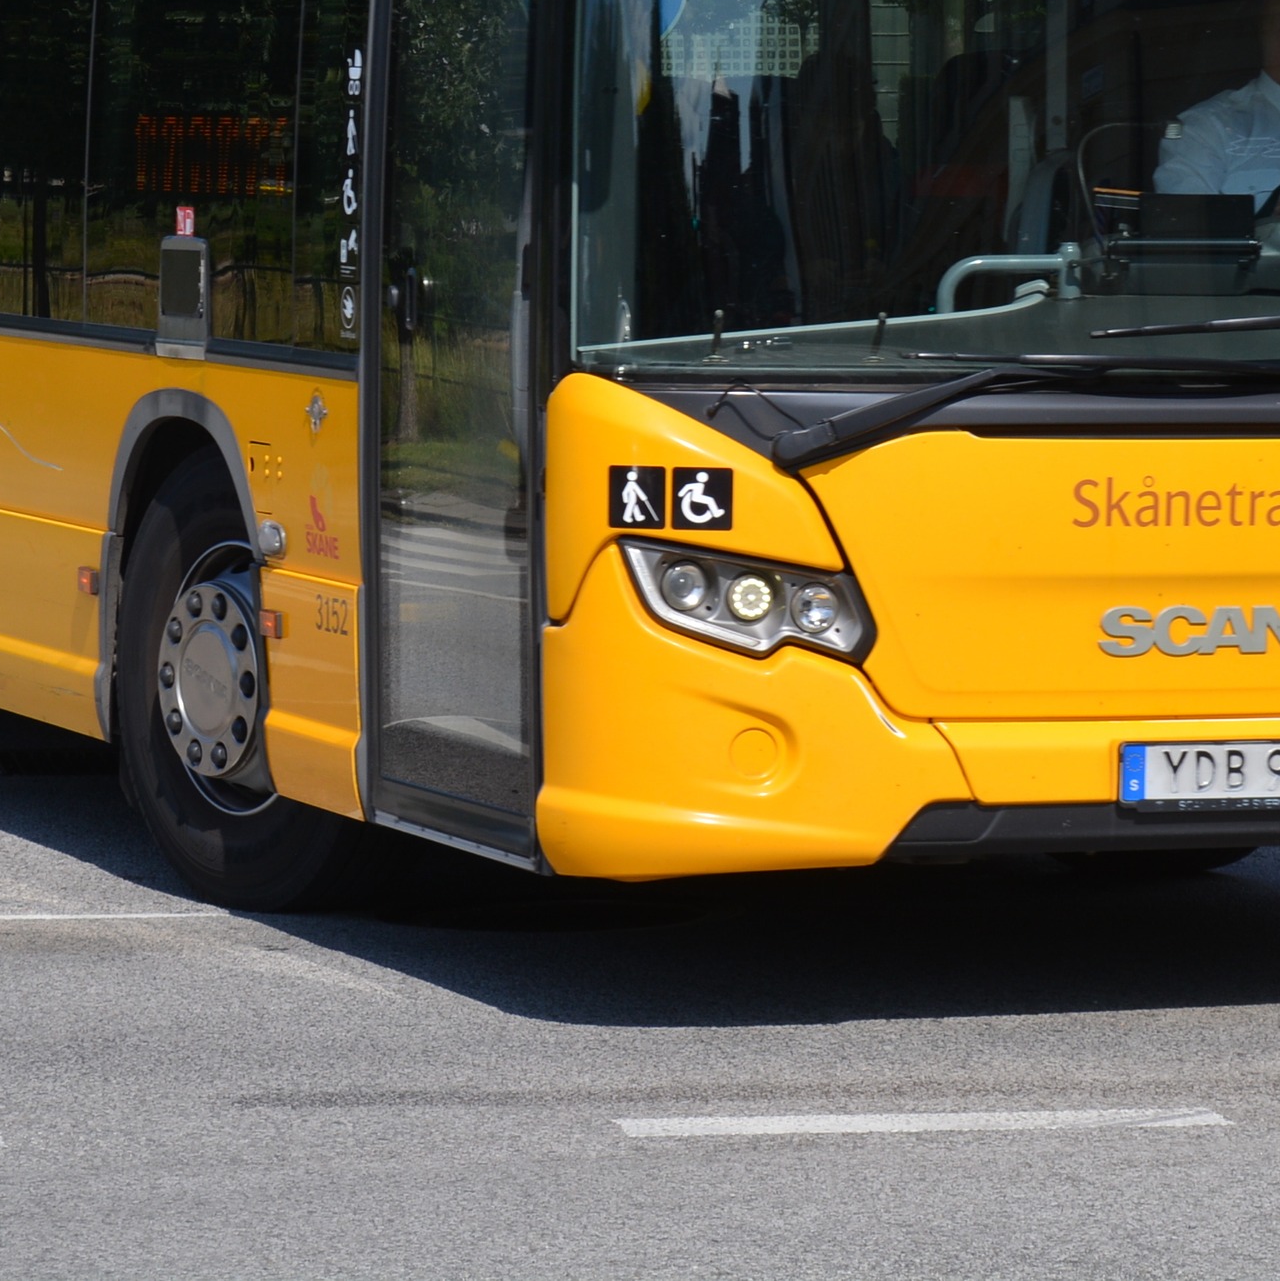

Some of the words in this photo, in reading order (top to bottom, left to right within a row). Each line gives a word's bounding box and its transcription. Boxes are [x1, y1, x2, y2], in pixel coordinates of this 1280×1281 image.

[315, 594, 349, 636] 3152
[1129, 779, 1140, 792] S
[1163, 748, 1246, 793] YDB
